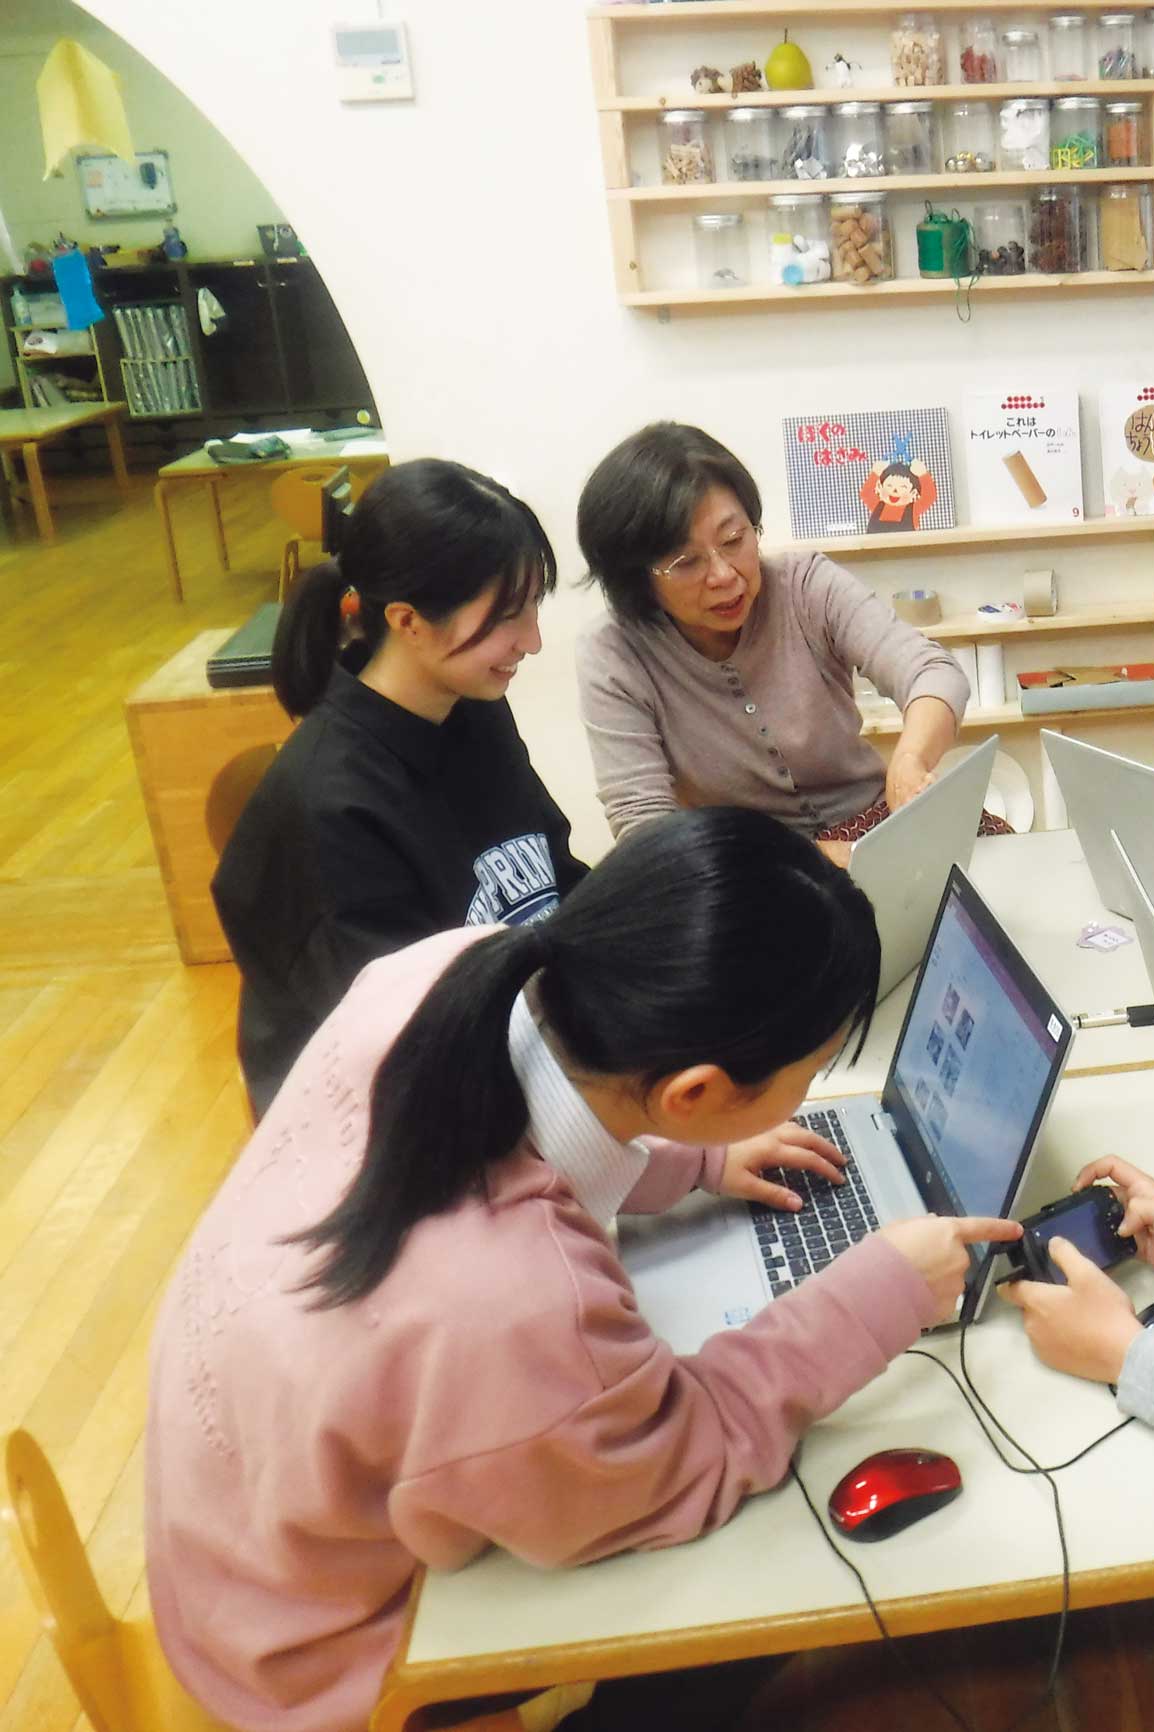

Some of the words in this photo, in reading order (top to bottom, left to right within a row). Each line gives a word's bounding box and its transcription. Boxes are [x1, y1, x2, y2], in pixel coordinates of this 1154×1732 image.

[1006, 417, 1037, 427] これは
[797, 421, 847, 443] ぼくの
[813, 447, 867, 468] はさみ
[1072, 507, 1080, 518] 9
